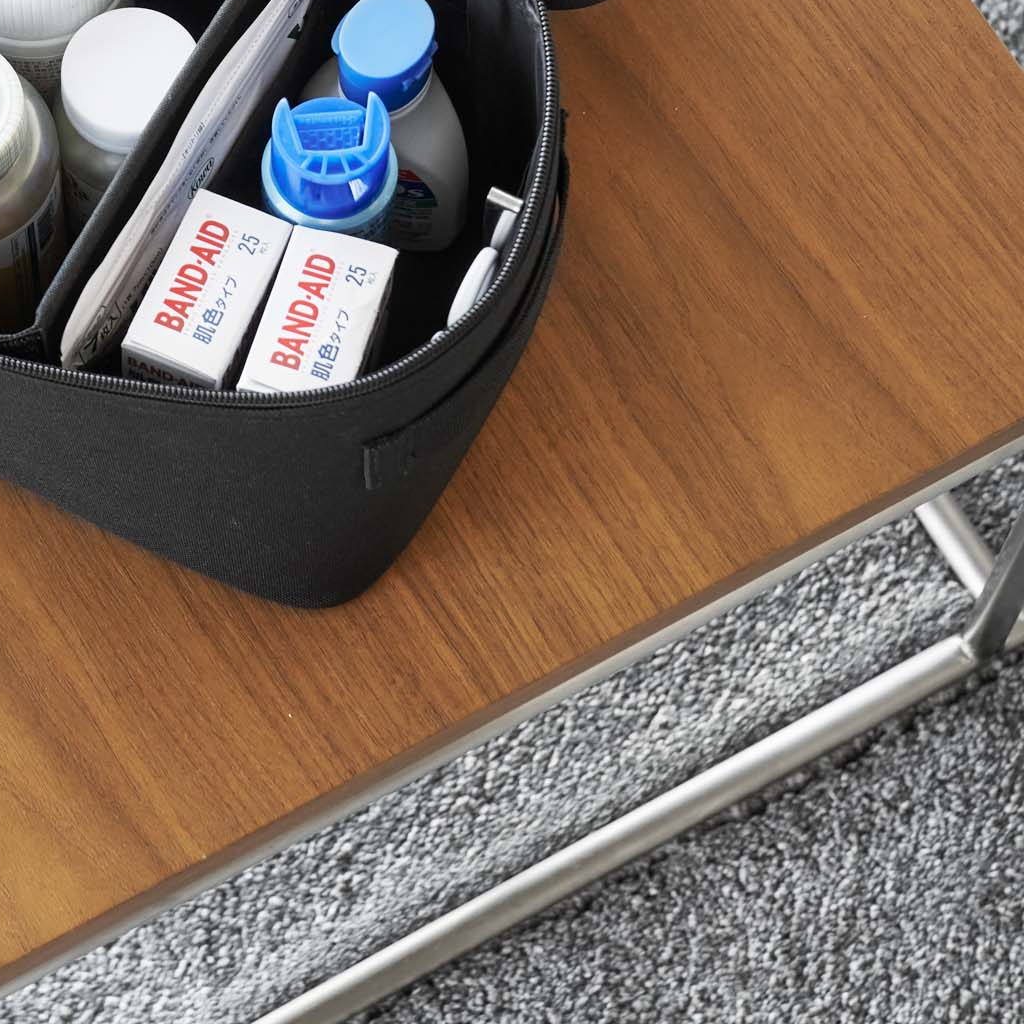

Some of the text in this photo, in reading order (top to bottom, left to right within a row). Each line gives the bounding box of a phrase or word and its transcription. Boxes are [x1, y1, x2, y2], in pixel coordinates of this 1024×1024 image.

[238, 233, 260, 255] 25
[346, 265, 368, 287] 25
[193, 276, 238, 344] 肌色タイプ
[311, 308, 350, 382] 肌色タイプ
